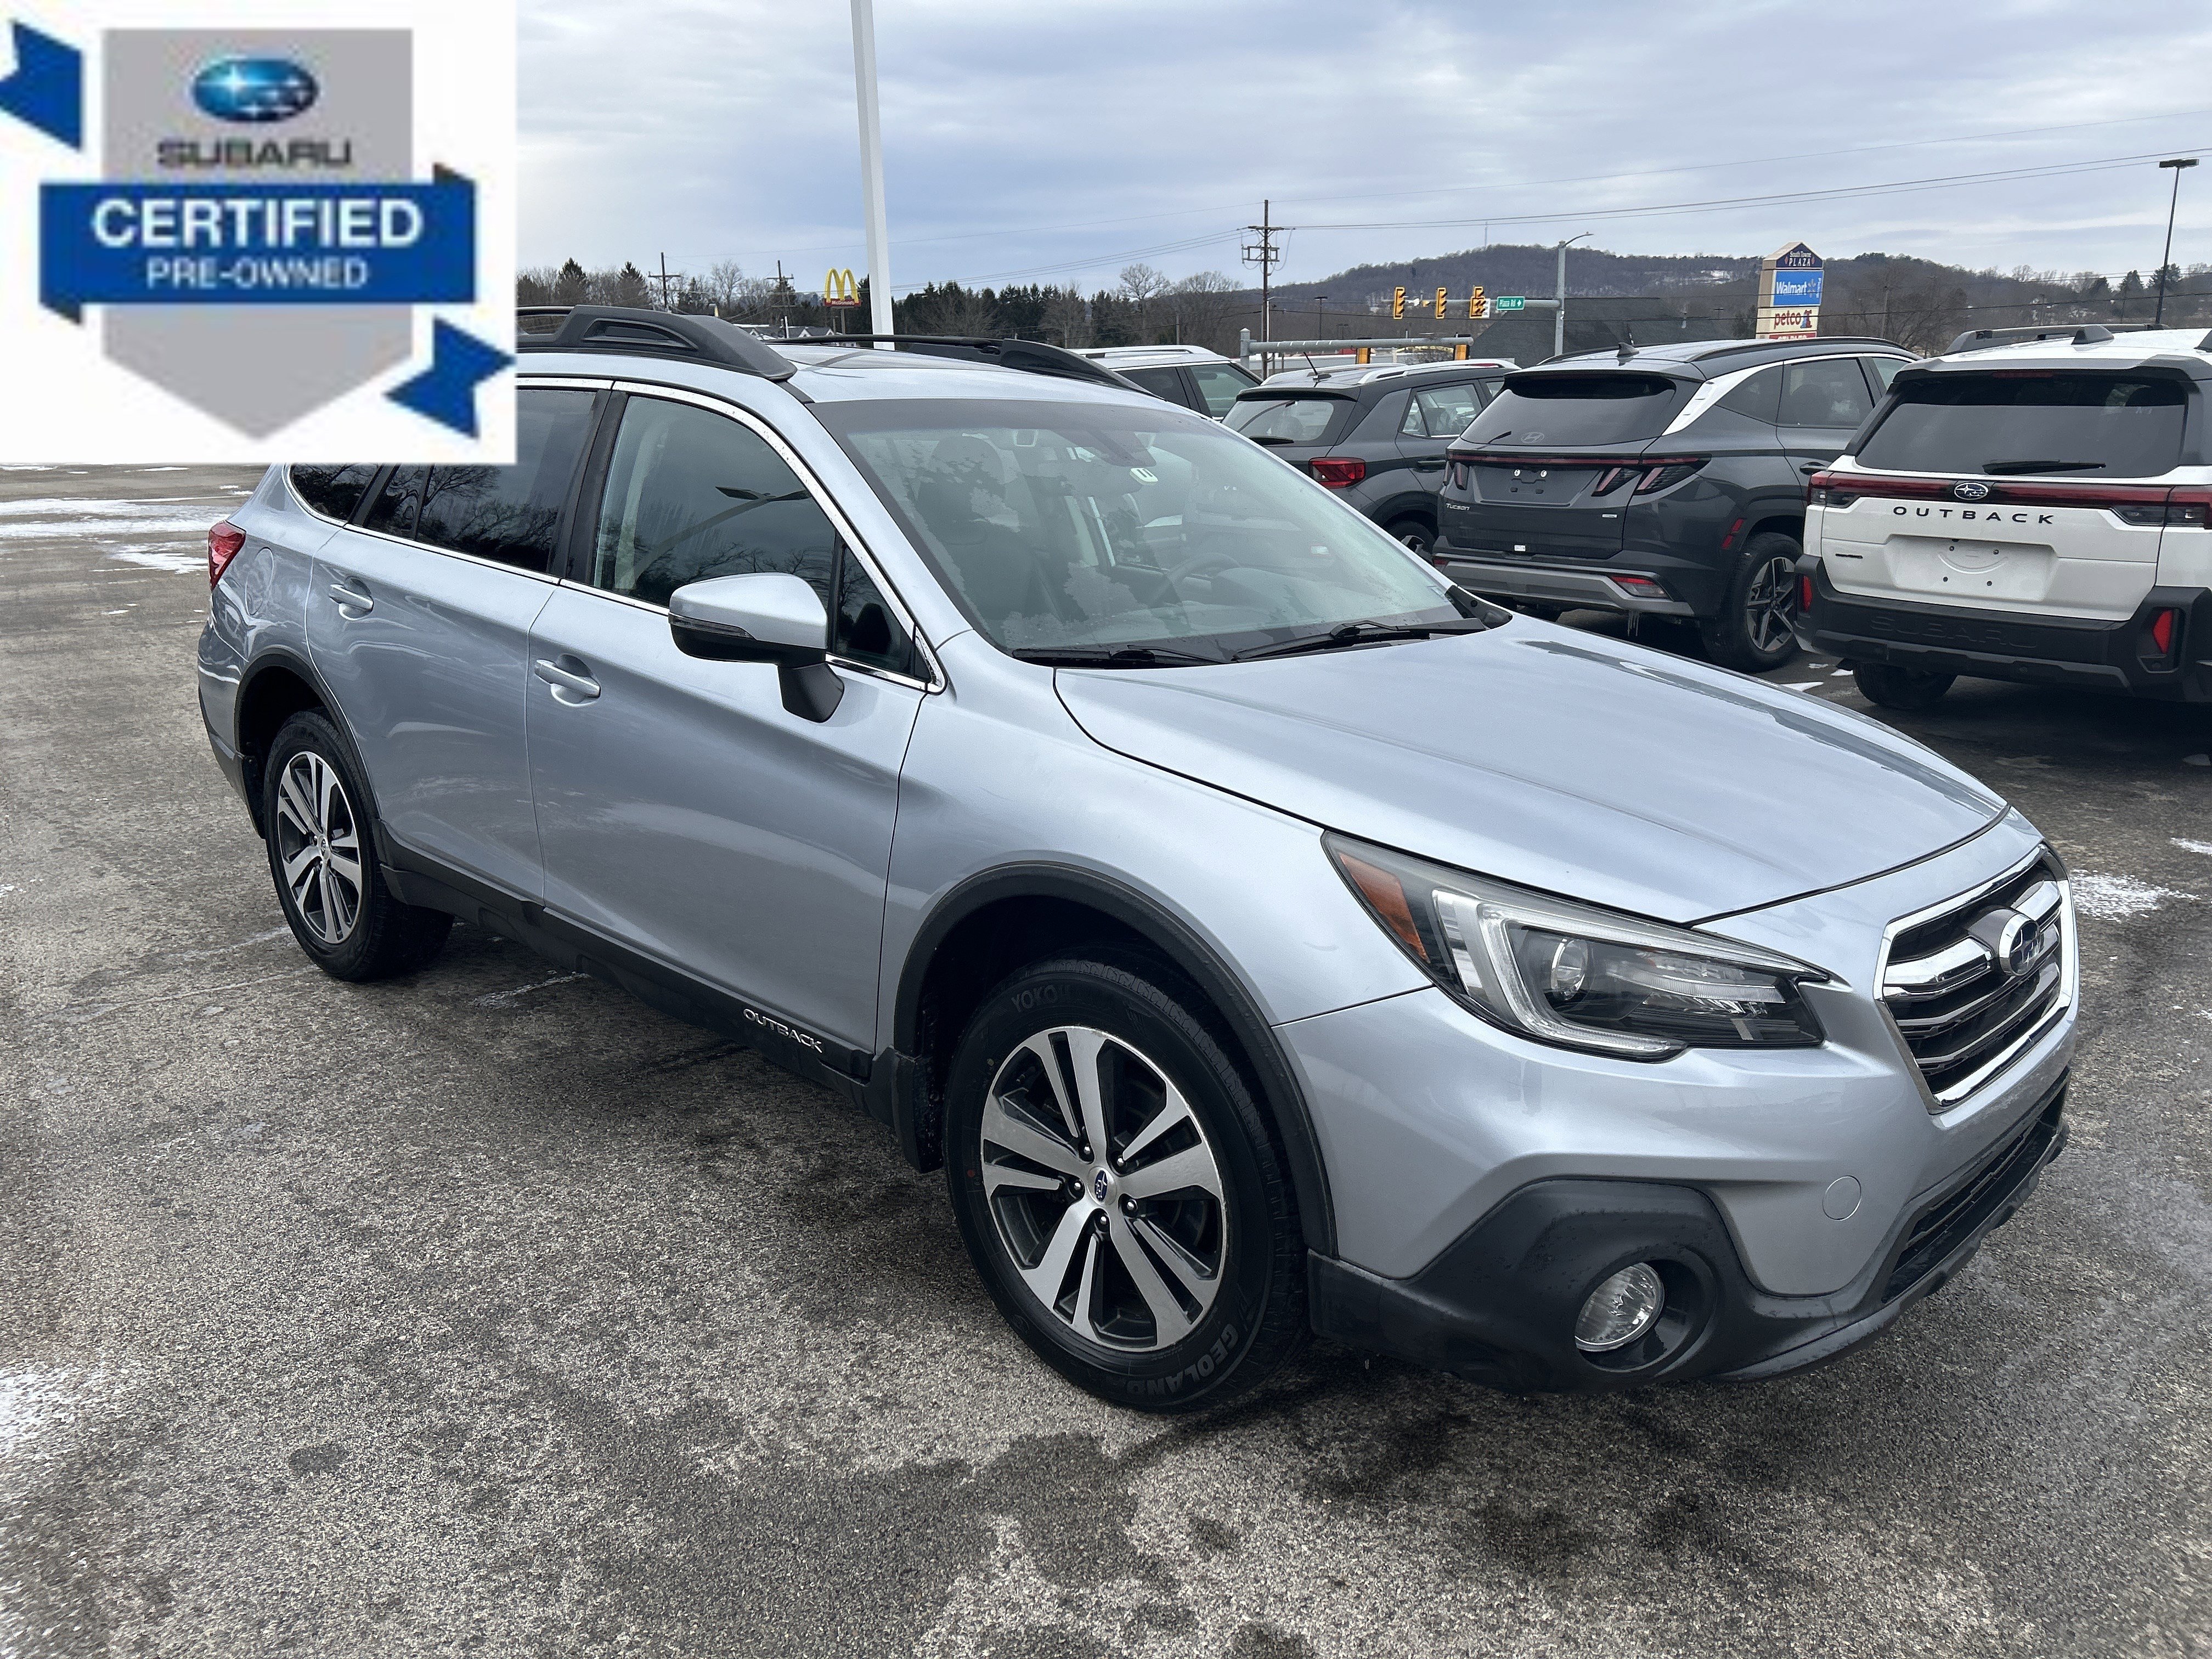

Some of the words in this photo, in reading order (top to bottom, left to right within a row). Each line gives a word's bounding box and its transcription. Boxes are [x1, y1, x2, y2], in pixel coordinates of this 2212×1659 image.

[1788, 258, 1811, 266] PLAZA
[1776, 281, 1807, 295] Walmart
[1774, 310, 1801, 329] petco
[1893, 506, 2055, 525] OUTBACK
[1870, 616, 2038, 649] SUBARU
[743, 1008, 823, 1053] OUTBACK
